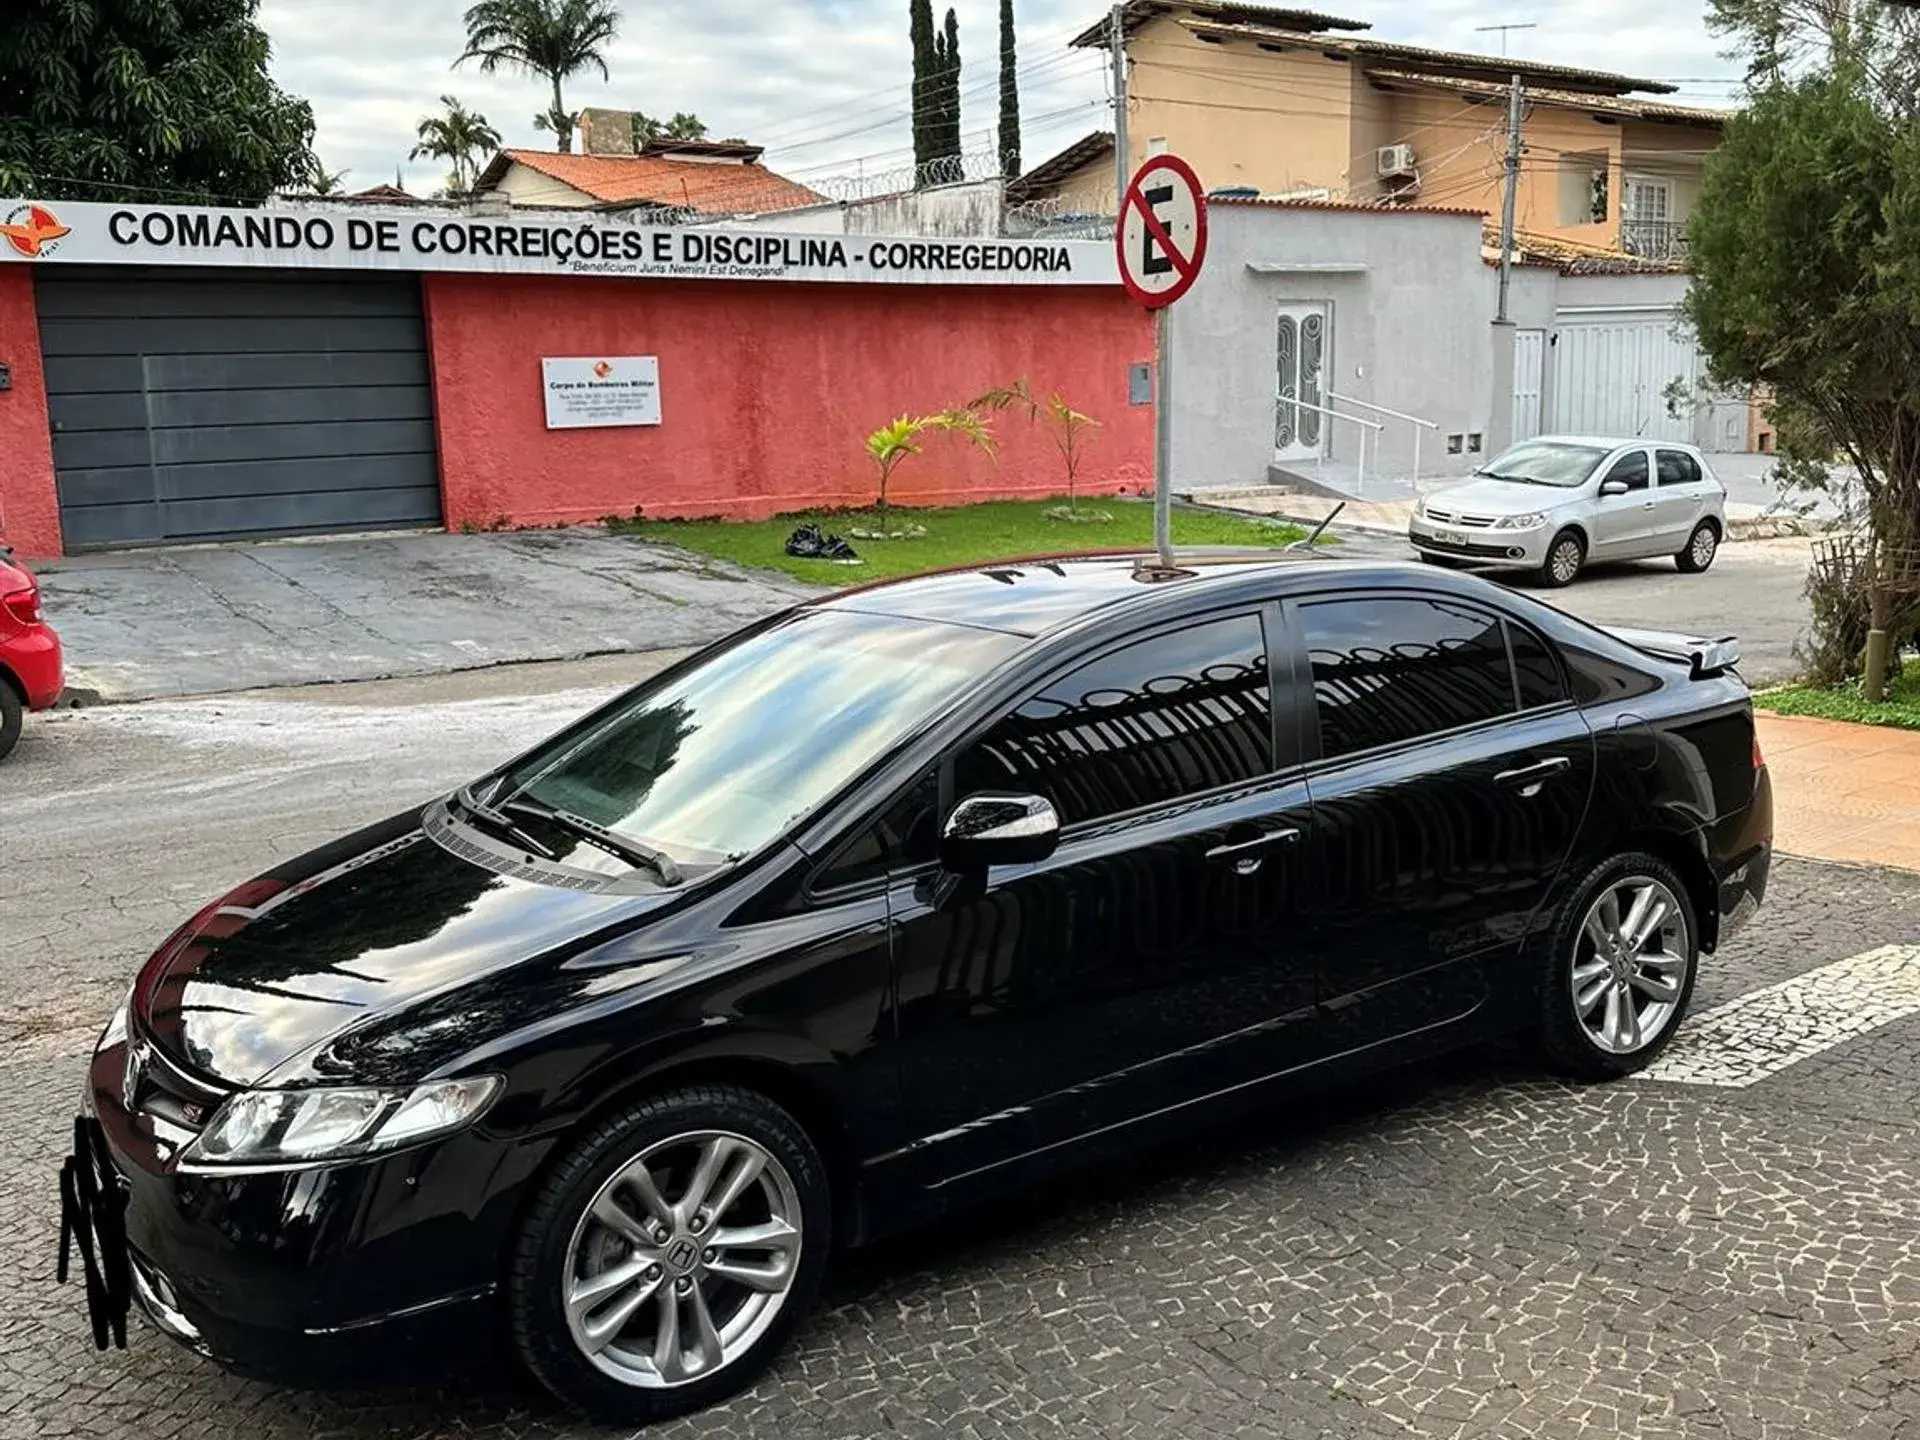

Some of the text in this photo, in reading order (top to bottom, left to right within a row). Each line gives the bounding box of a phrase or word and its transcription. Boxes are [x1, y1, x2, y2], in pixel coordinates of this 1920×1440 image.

[108, 211, 334, 250] COMANDO
[347, 219, 401, 253] DE
[411, 222, 643, 265] CORREIÇÕES
[653, 233, 673, 262] E
[682, 234, 847, 268] DISCIPLINA
[869, 242, 1072, 272] CORREGEDORIA
[1143, 184, 1174, 276] E
